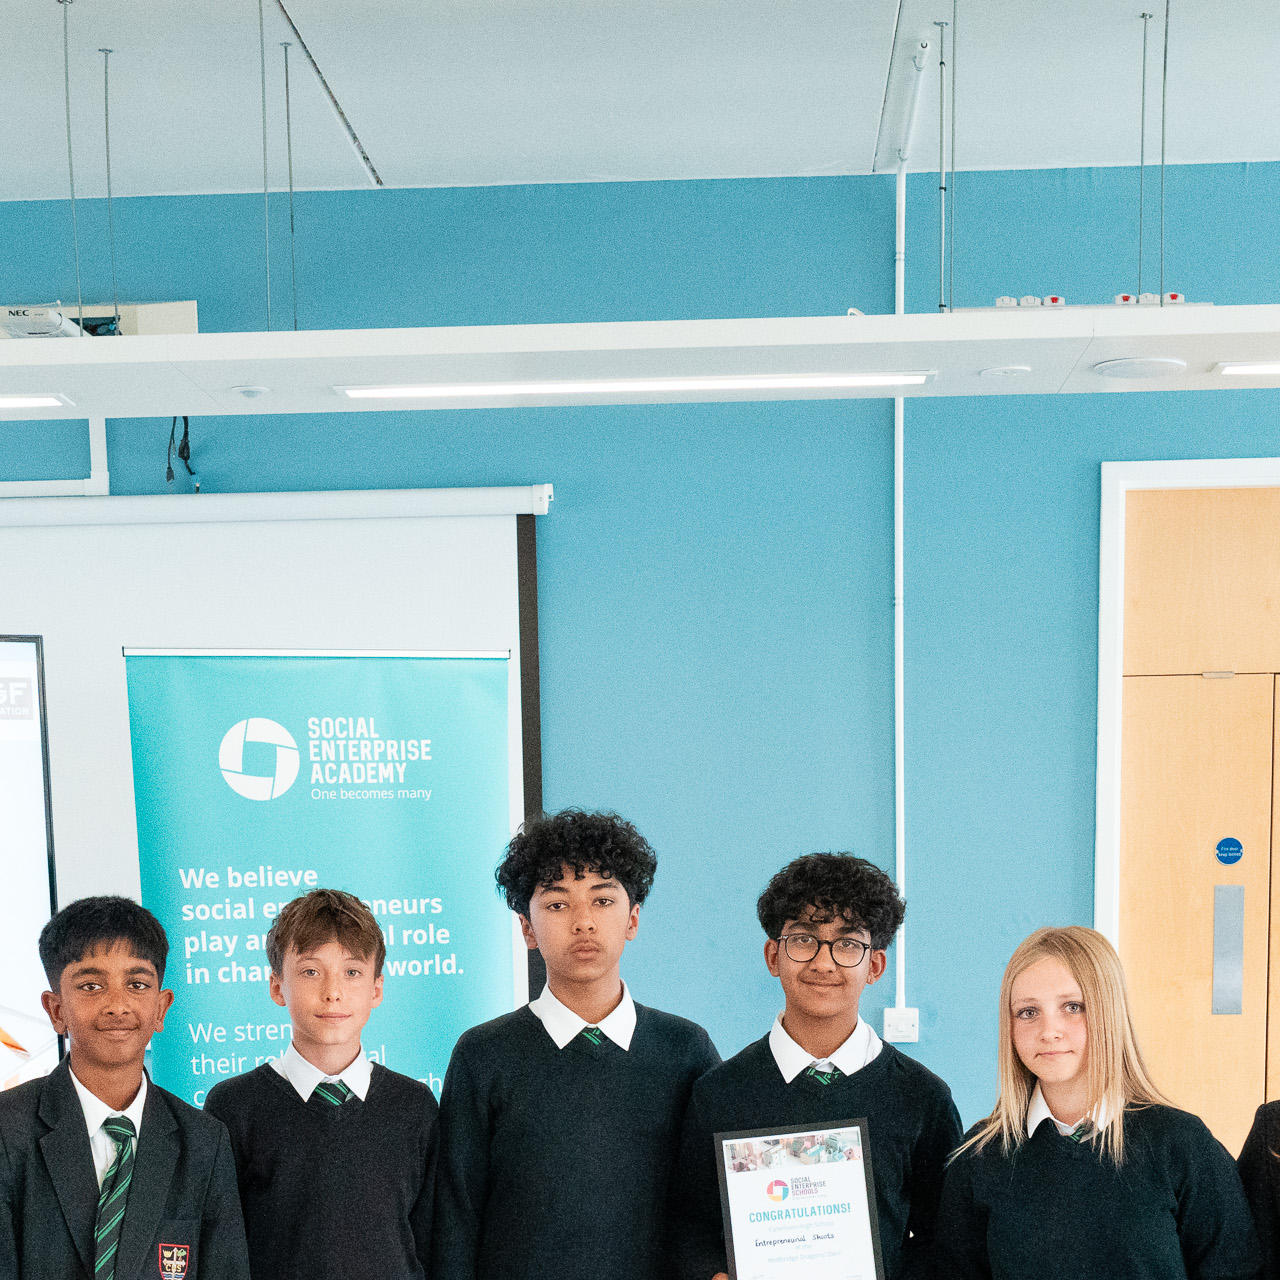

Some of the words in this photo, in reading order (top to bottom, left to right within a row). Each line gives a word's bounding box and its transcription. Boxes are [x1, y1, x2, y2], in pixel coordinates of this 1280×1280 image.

[8, 309, 30, 317] NEC
[308, 717, 380, 739] SOCIAL
[309, 739, 432, 761] ENTERPRISE
[310, 762, 407, 784] ACADEMY
[311, 788, 337, 800] One
[340, 788, 394, 800] becomes
[397, 789, 432, 801] many
[179, 868, 220, 889] We
[227, 866, 318, 888] believe
[182, 898, 254, 921] social
[184, 931, 239, 958] play
[402, 924, 450, 945] role
[186, 963, 210, 984] in
[386, 954, 464, 976] world.
[189, 1022, 227, 1043] We
[234, 1021, 294, 1042] stren
[191, 1052, 248, 1075] their
[790, 1176, 811, 1184] SOCIAL
[791, 1180, 827, 1190] ENTERPRISE
[791, 1187, 819, 1197] SCHOOLS
[749, 1202, 851, 1223] CONGRATULATIONS!
